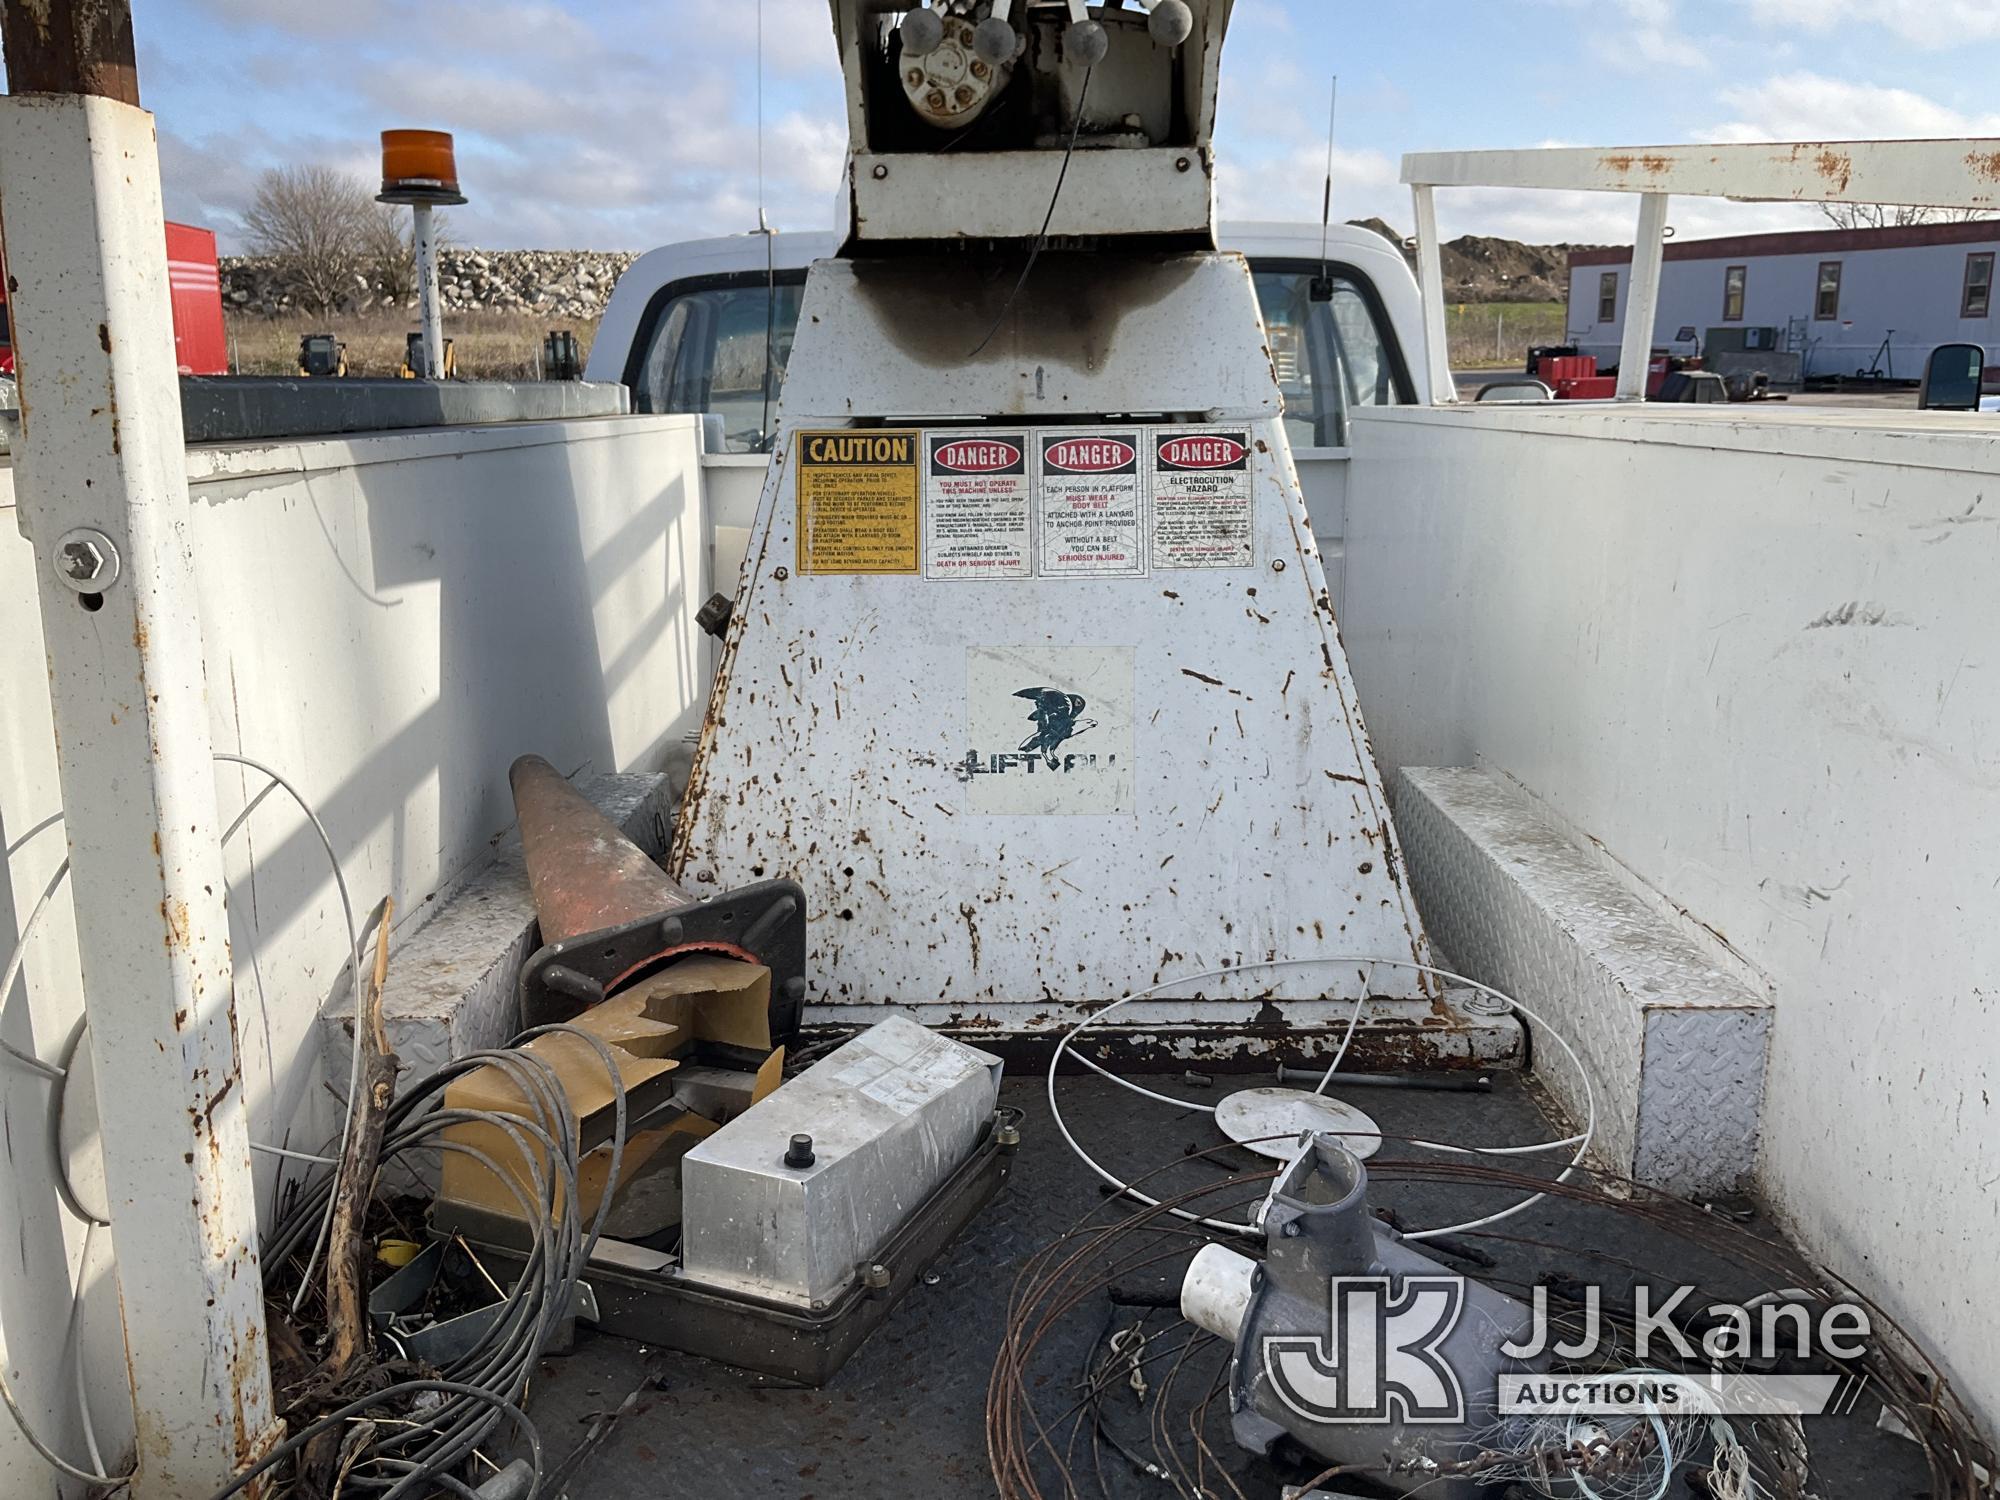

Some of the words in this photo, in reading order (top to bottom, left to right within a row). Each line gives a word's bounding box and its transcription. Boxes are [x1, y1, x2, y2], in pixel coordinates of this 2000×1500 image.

[809, 437, 908, 462] CAUTION
[947, 446, 1007, 466] DANGER
[1058, 445, 1121, 465] DANGER
[1171, 442, 1232, 462] DANGER
